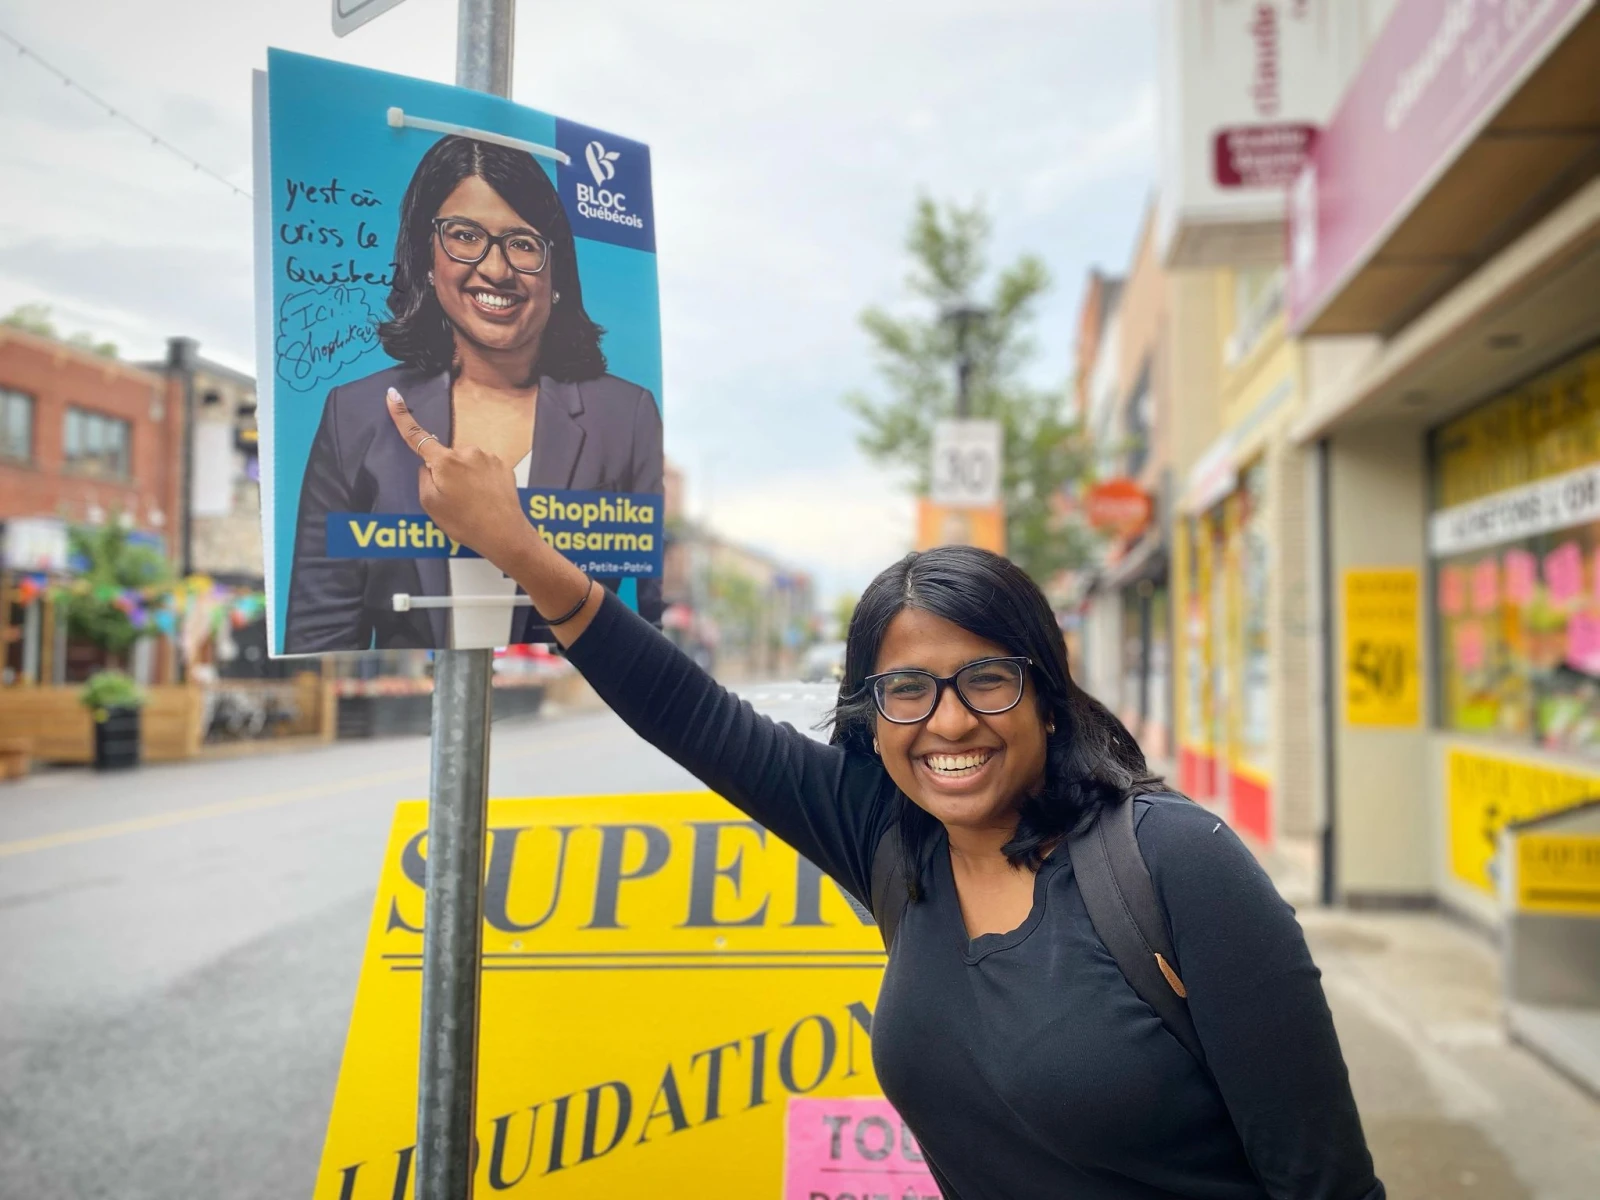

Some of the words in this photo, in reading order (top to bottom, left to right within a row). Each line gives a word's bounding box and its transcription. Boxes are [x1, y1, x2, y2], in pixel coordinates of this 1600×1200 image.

[576, 182, 627, 211] BLOC
[577, 201, 644, 229] Québécois
[529, 494, 654, 528] Shophika
[588, 561, 653, 573] Petite-Patrie
